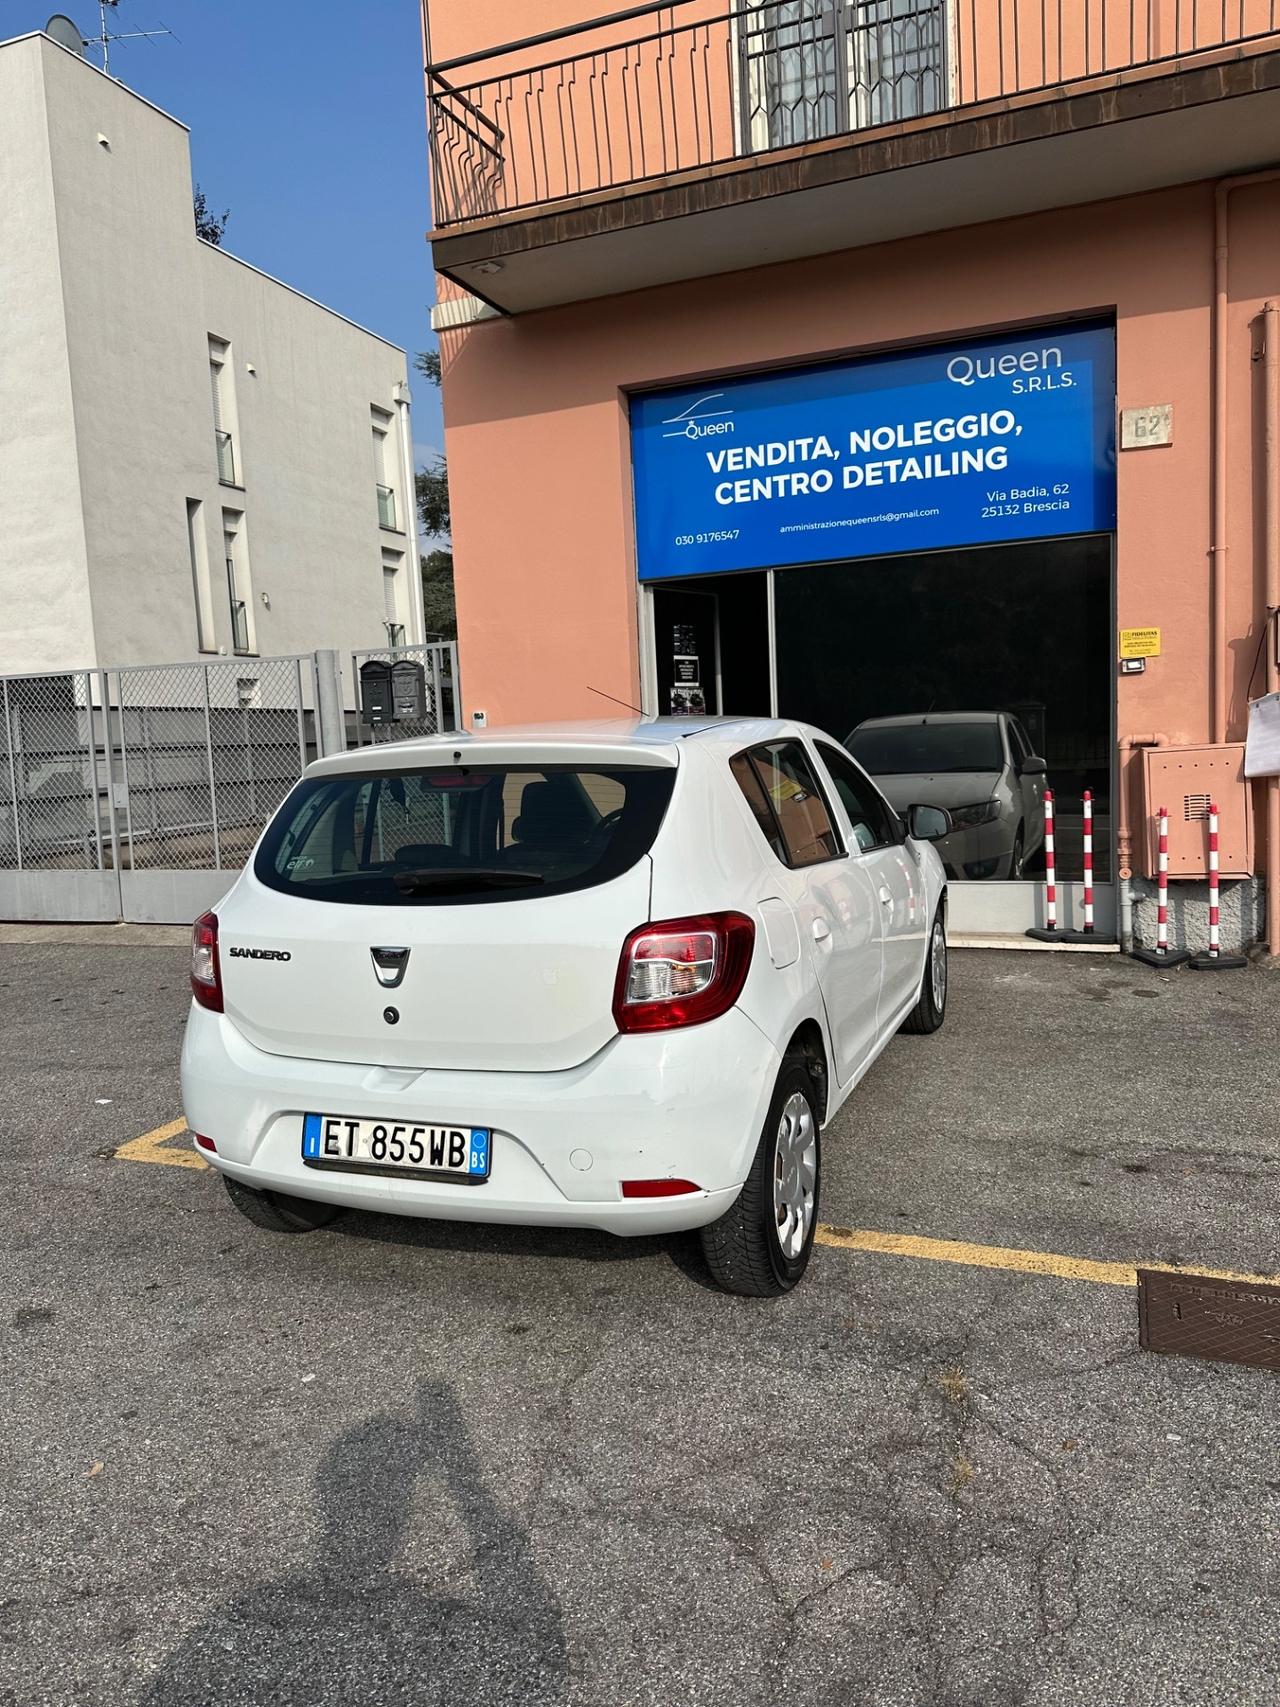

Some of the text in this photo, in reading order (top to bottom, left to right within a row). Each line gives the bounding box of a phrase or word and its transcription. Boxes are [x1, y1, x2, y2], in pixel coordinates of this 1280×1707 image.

[946, 347, 1062, 386] Queen
[1012, 372, 1077, 394] S.R.L.S.
[685, 421, 734, 440] Queen
[706, 410, 1022, 474] VENDITA, NOLEGGIO,
[715, 446, 1008, 505] CENTRO DETAILING
[986, 483, 1070, 502] Via Badia, 62
[981, 499, 1070, 518] 25132 Brescia
[779, 508, 940, 534] amministrazionequeensrls@gmail.com
[675, 529, 740, 546] 030 9176547
[229, 947, 292, 961] SANDERO
[324, 1119, 360, 1156] ET
[371, 1125, 466, 1168] 855WB
[471, 1151, 486, 1168] BS
